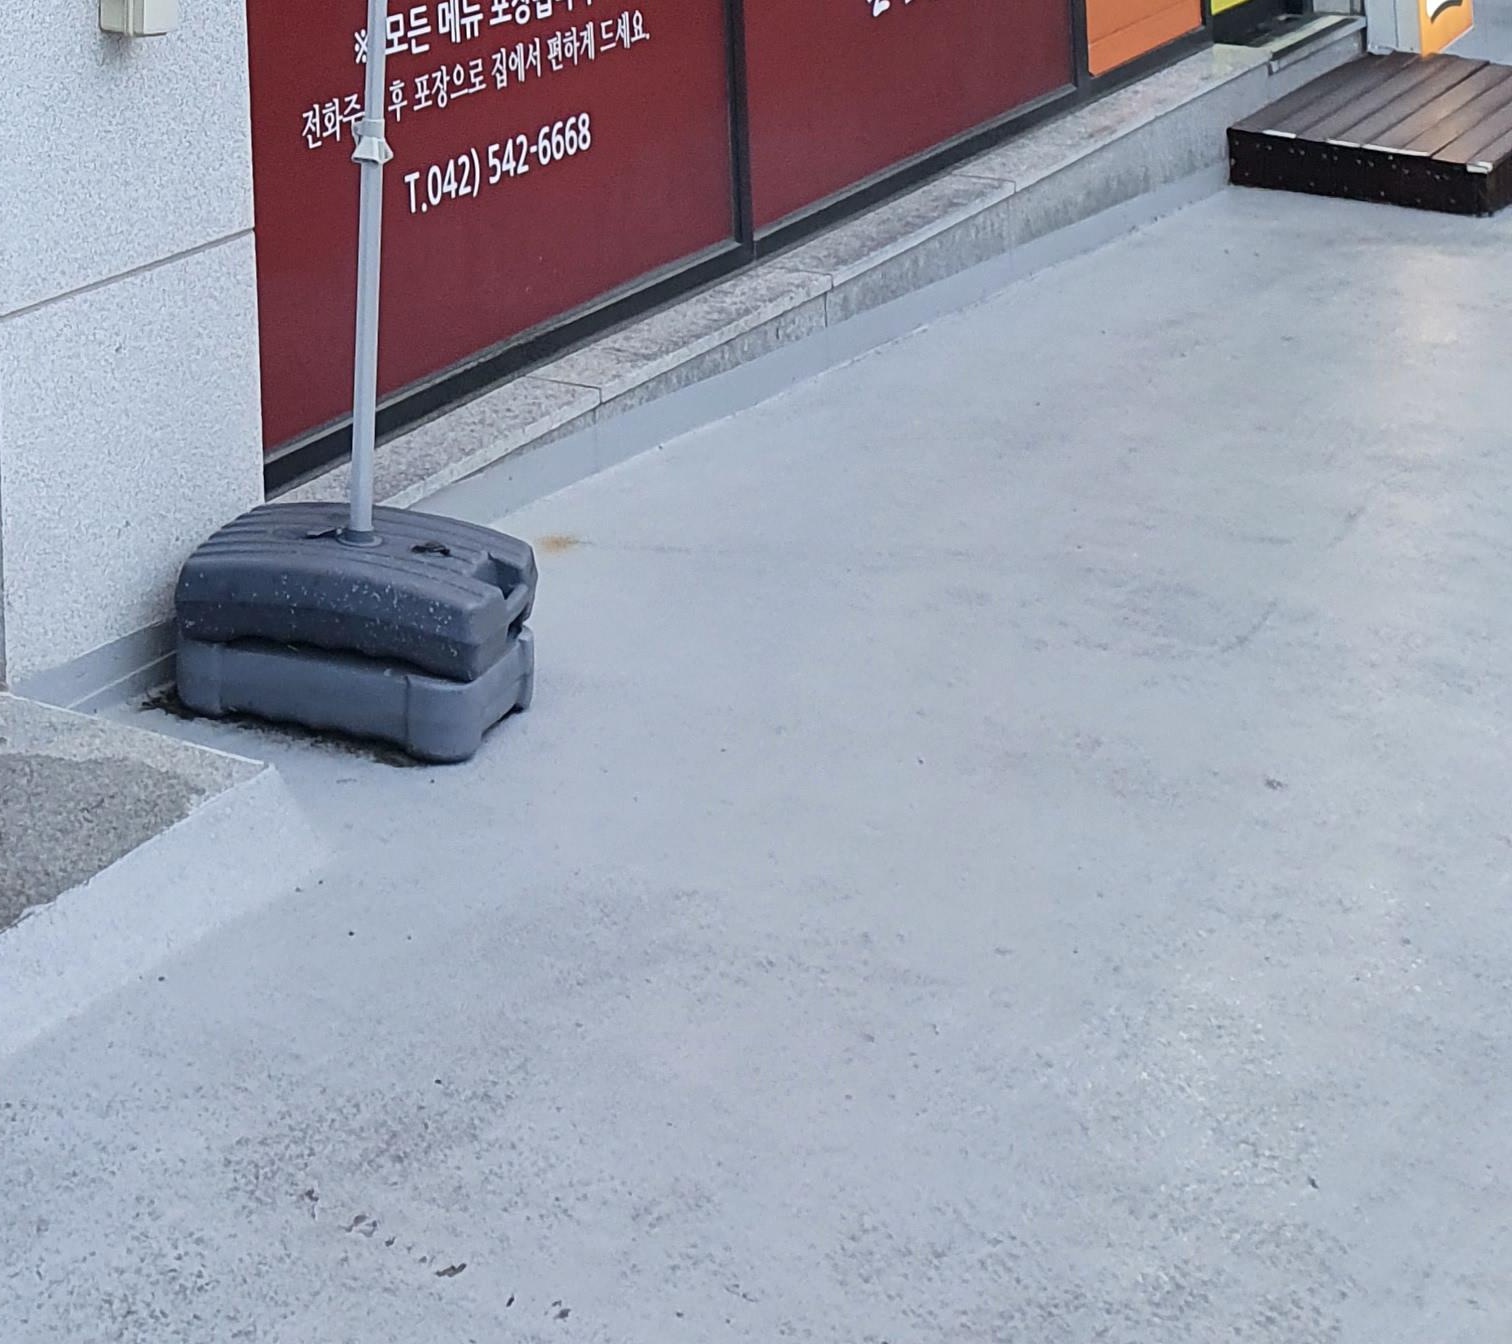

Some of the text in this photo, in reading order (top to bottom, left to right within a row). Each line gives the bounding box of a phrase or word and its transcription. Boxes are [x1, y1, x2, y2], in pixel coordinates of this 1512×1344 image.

[385, 5, 432, 56] 모든
[388, 79, 408, 123] 후
[413, 58, 488, 110] 포장으로
[491, 37, 543, 90] 집에서
[547, 24, 597, 71] 편하게
[599, 9, 652, 53] 드세요.
[404, 112, 592, 215] T.042) 542-6668
